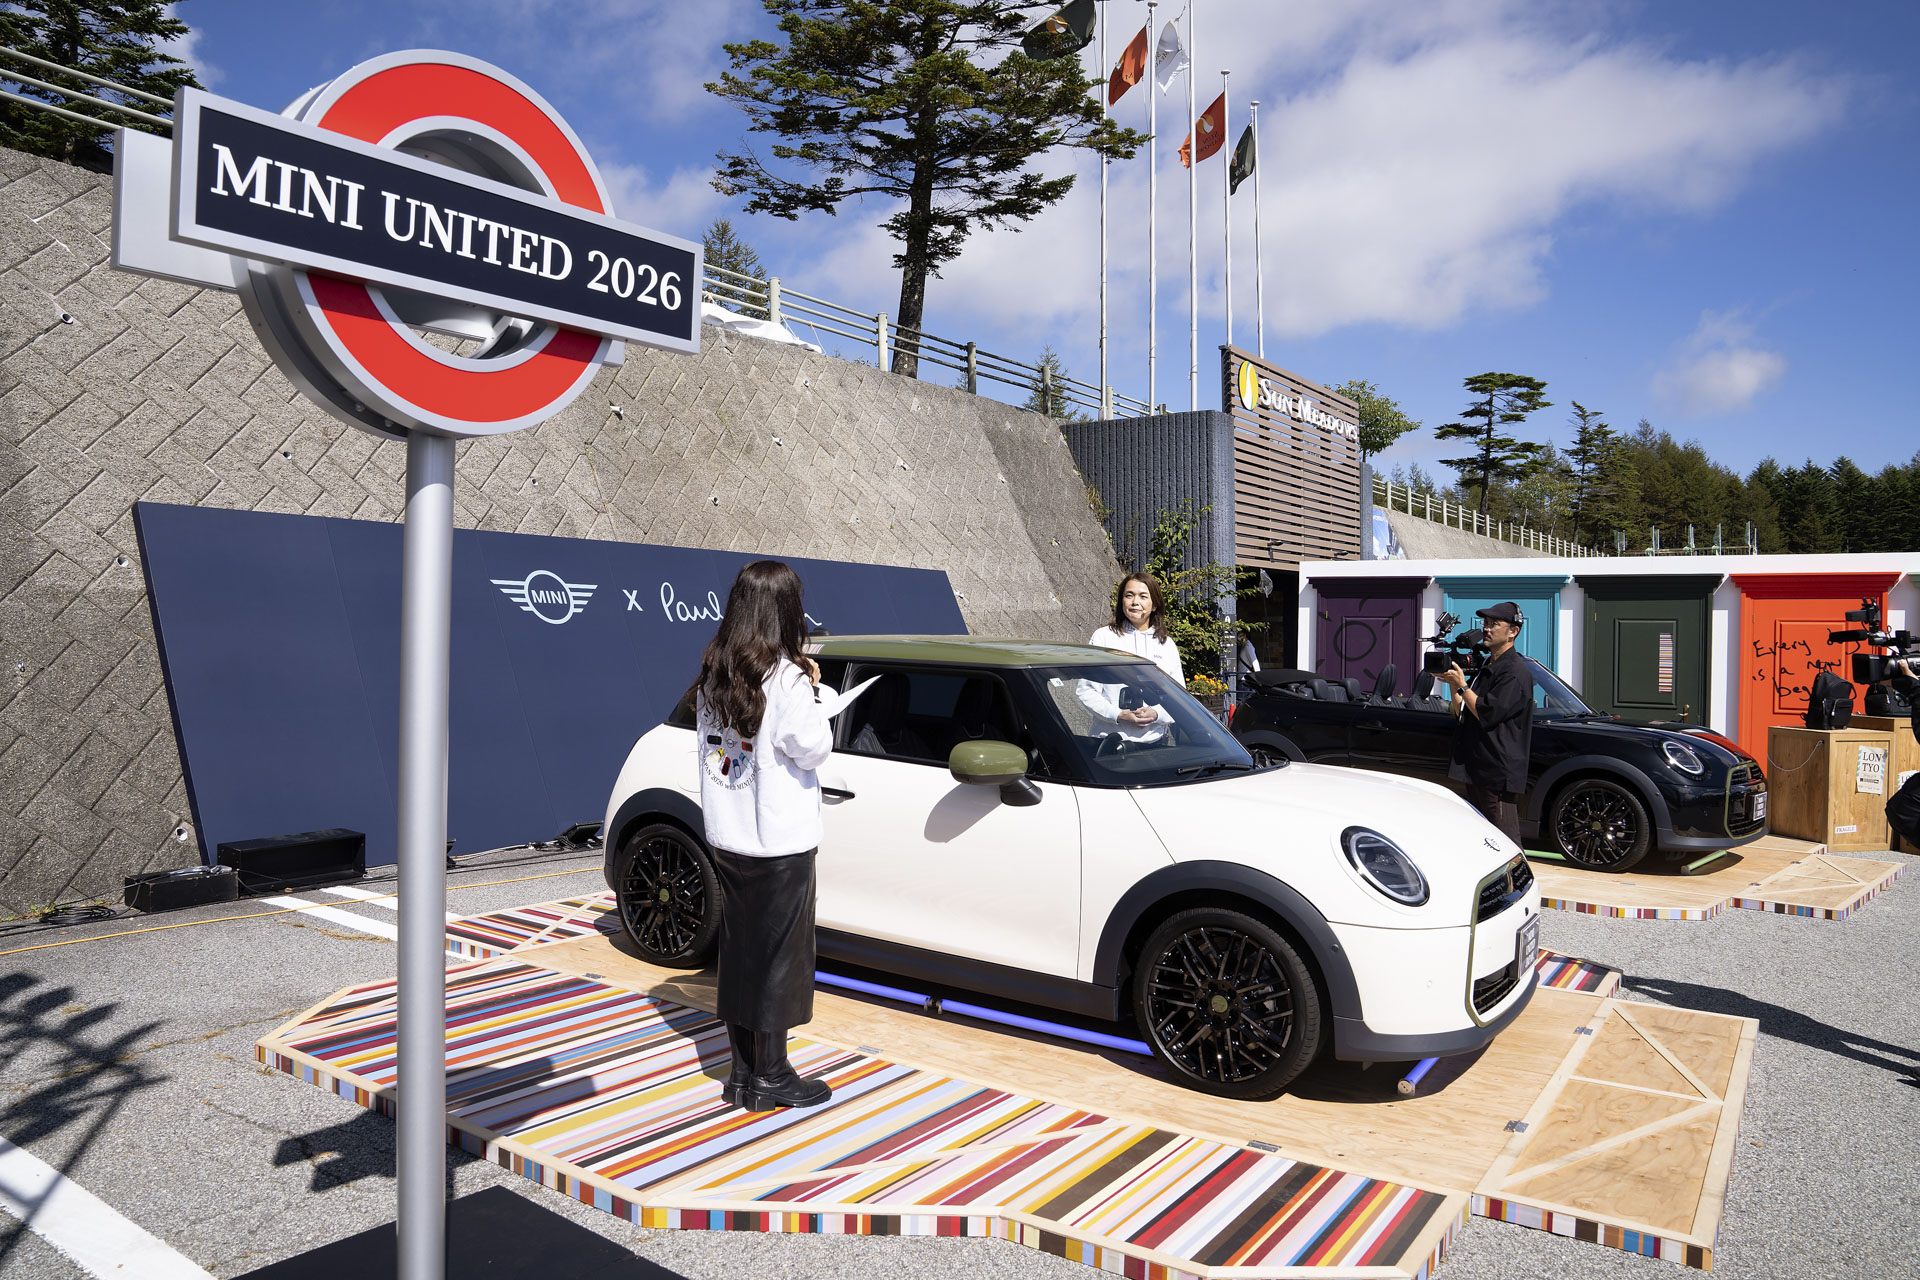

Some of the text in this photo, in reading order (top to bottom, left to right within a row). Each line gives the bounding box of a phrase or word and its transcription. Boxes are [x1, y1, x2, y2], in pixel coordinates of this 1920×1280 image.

[211, 143, 681, 310] MINI UNITED 2026
[531, 589, 568, 605] MINI
[660, 581, 724, 623] Paul
[1780, 667, 1795, 675] a
[1863, 751, 1882, 762] LON
[1862, 763, 1880, 773] TYO
[711, 774, 724, 787] 2026
